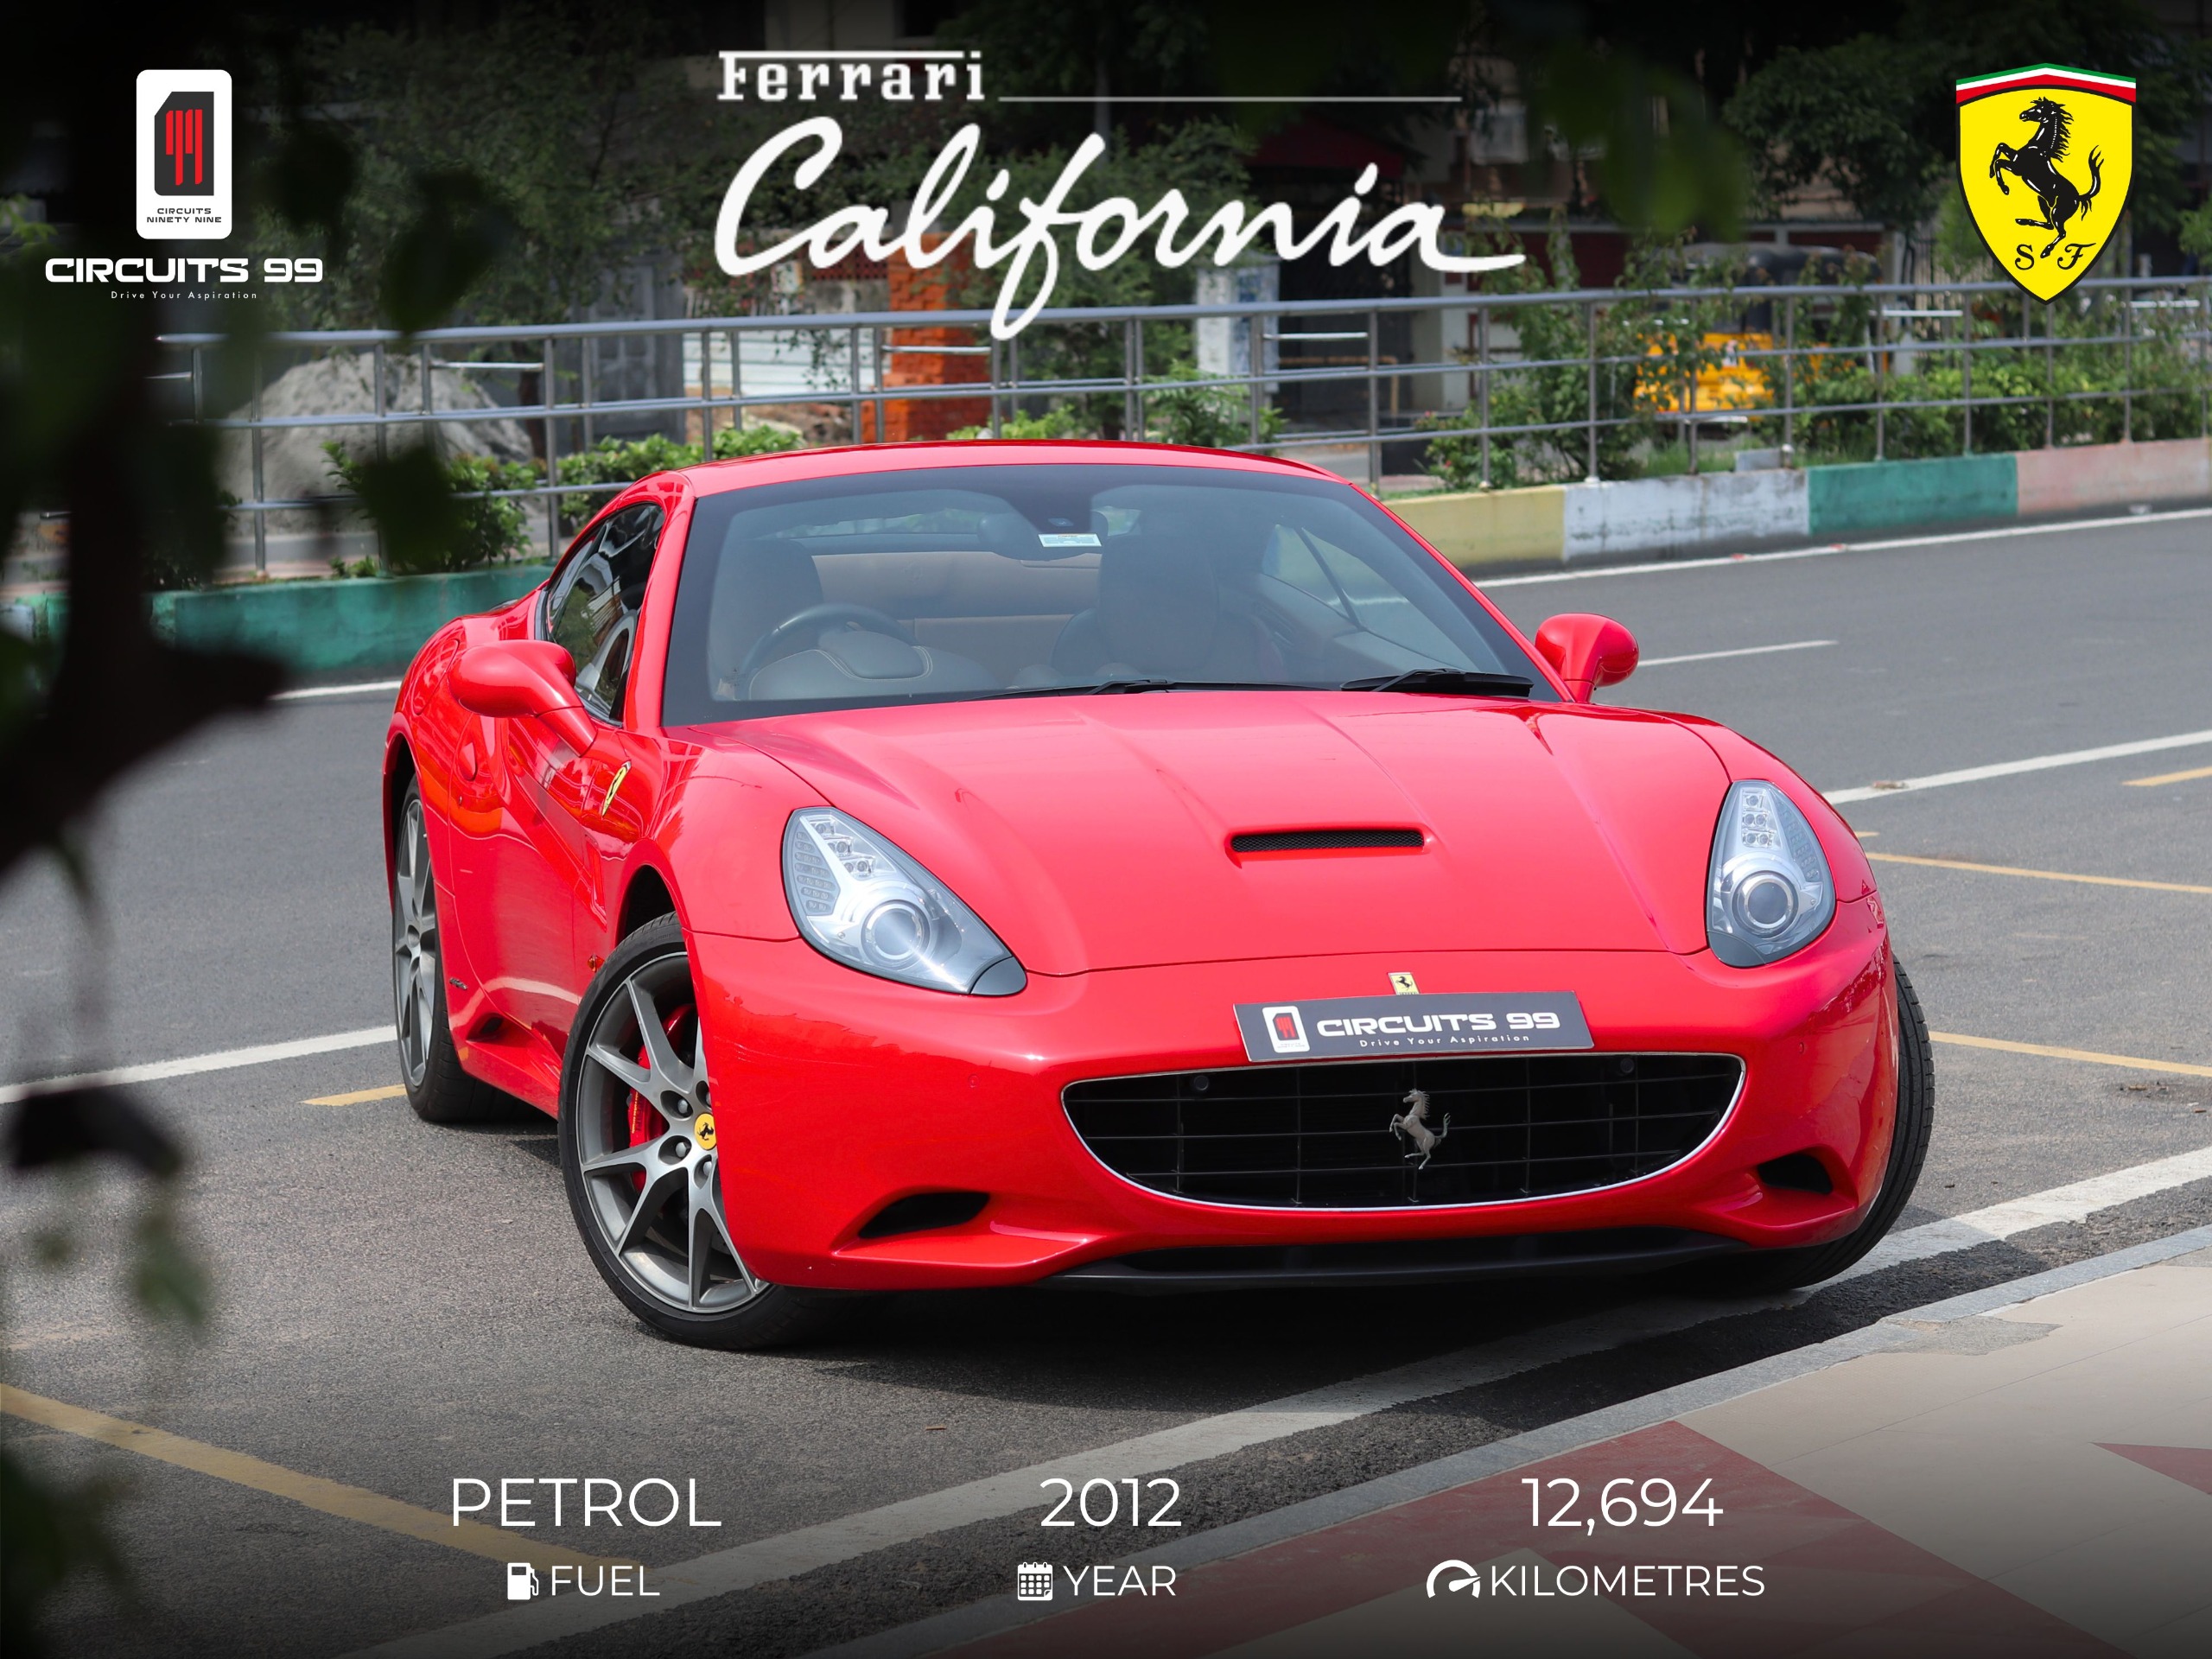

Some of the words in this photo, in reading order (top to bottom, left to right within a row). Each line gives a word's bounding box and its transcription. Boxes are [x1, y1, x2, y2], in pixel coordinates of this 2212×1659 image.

[1316, 1013, 1497, 1037] CIRCUITS
[1505, 1012, 1561, 1030] 99
[1359, 1039, 1401, 1048] Drive
[1407, 1037, 1442, 1046] Your
[1450, 1035, 1530, 1045] Aspiration
